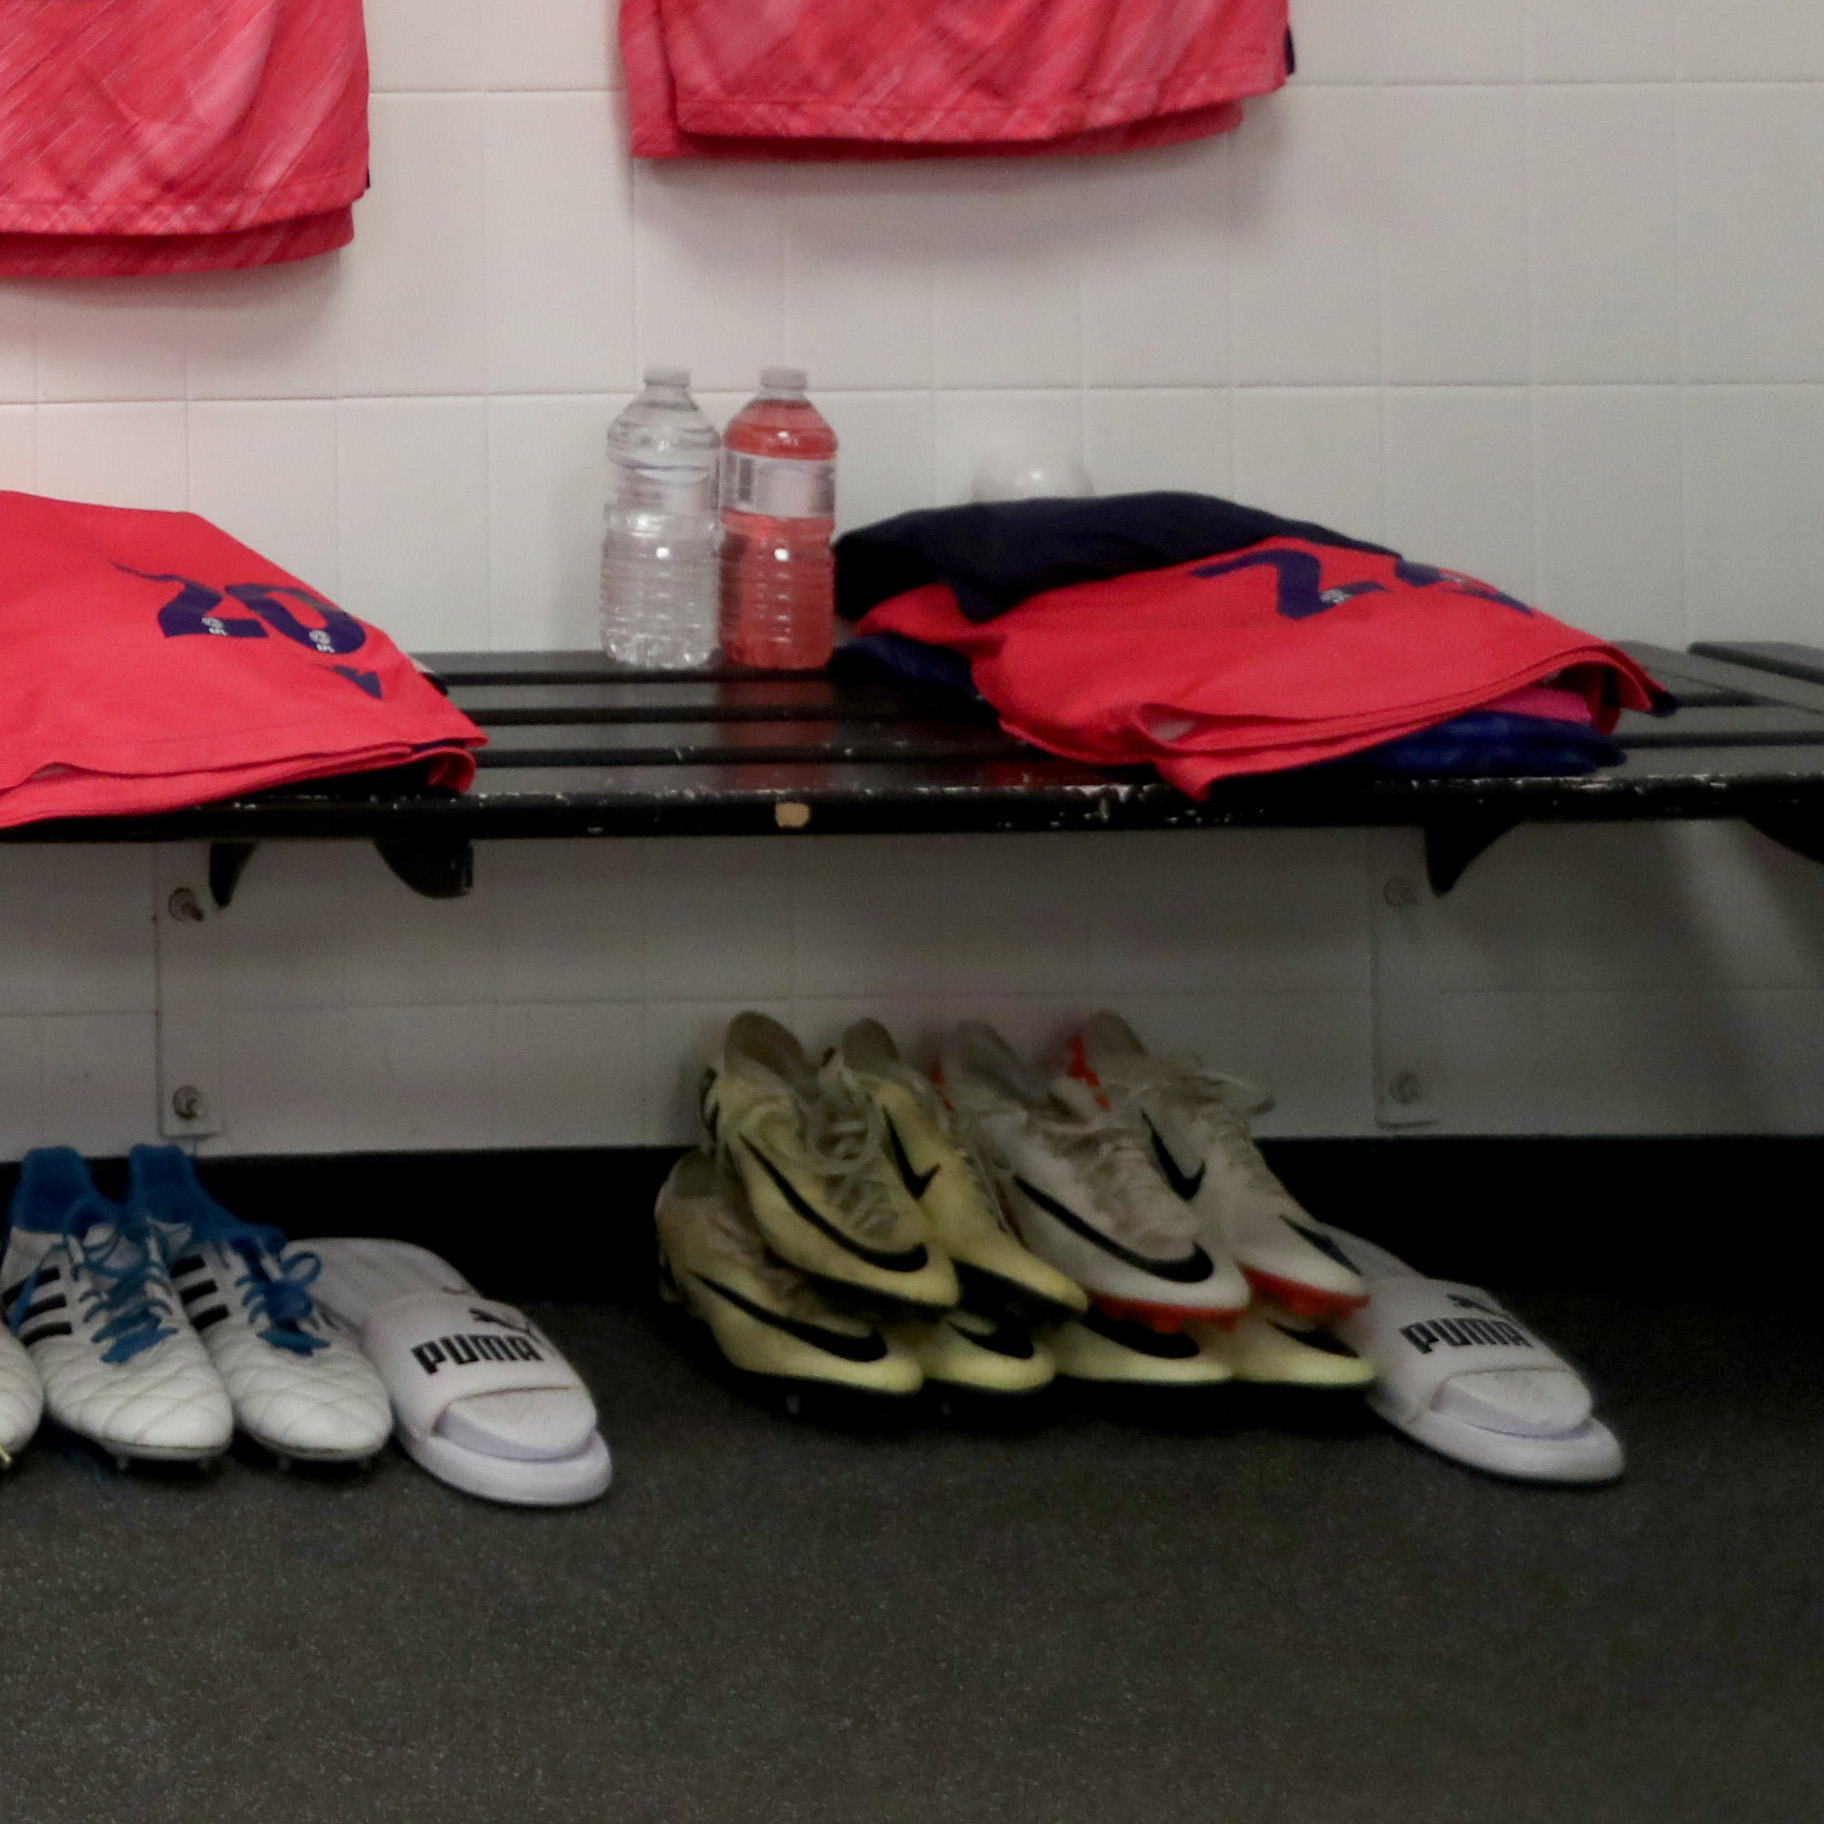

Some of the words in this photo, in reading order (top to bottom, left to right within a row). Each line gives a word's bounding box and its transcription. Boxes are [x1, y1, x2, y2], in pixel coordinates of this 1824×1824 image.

[109, 560, 366, 655] 20
[410, 1333, 545, 1376] PUMA
[1399, 1317, 1534, 1355] PUMA
